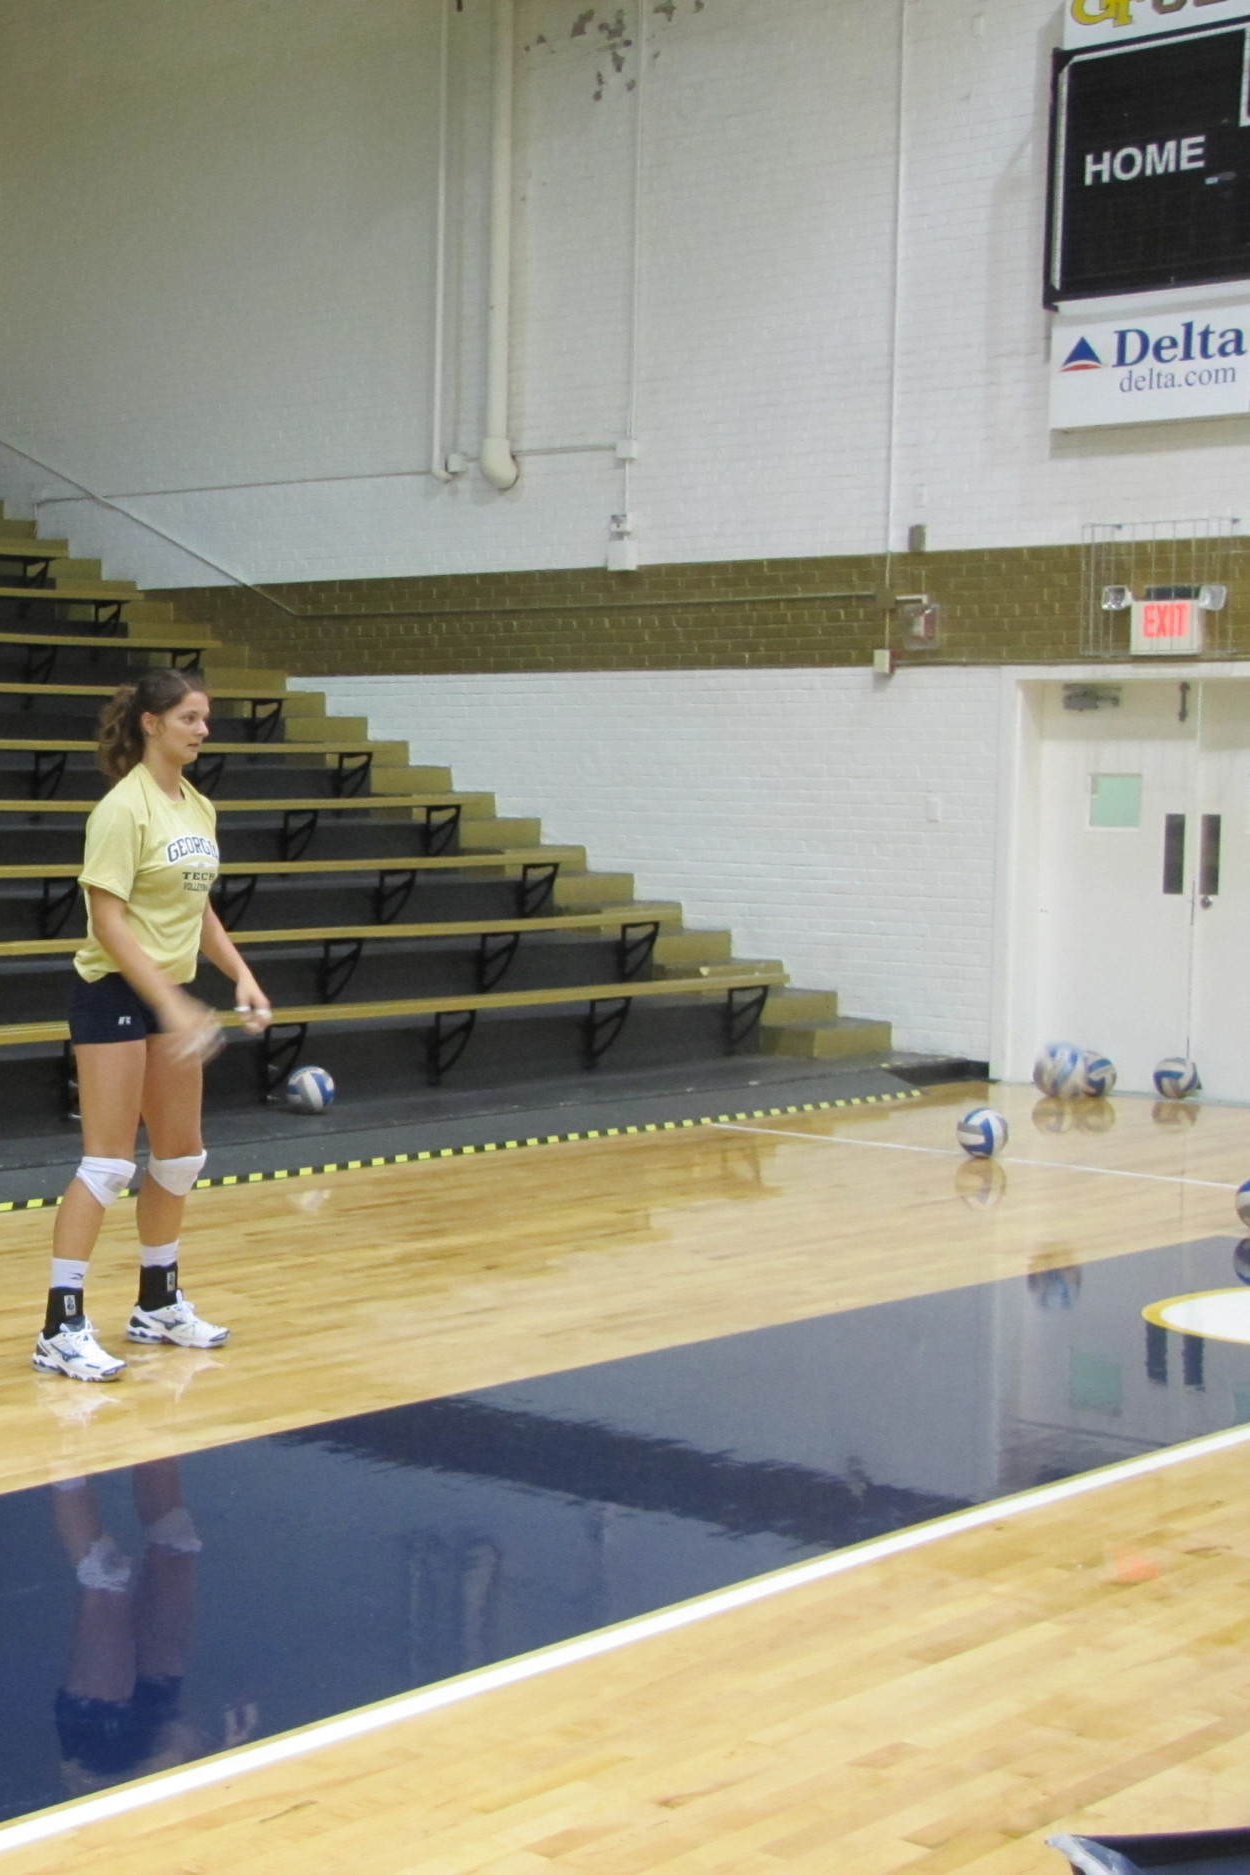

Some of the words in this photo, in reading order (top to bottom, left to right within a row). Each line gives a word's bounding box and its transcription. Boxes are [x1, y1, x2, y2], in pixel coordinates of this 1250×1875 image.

[1085, 136, 1206, 185] HOME
[1112, 321, 1247, 368] Delta
[1119, 368, 1236, 393] delta.com
[1143, 603, 1190, 638] EXIT
